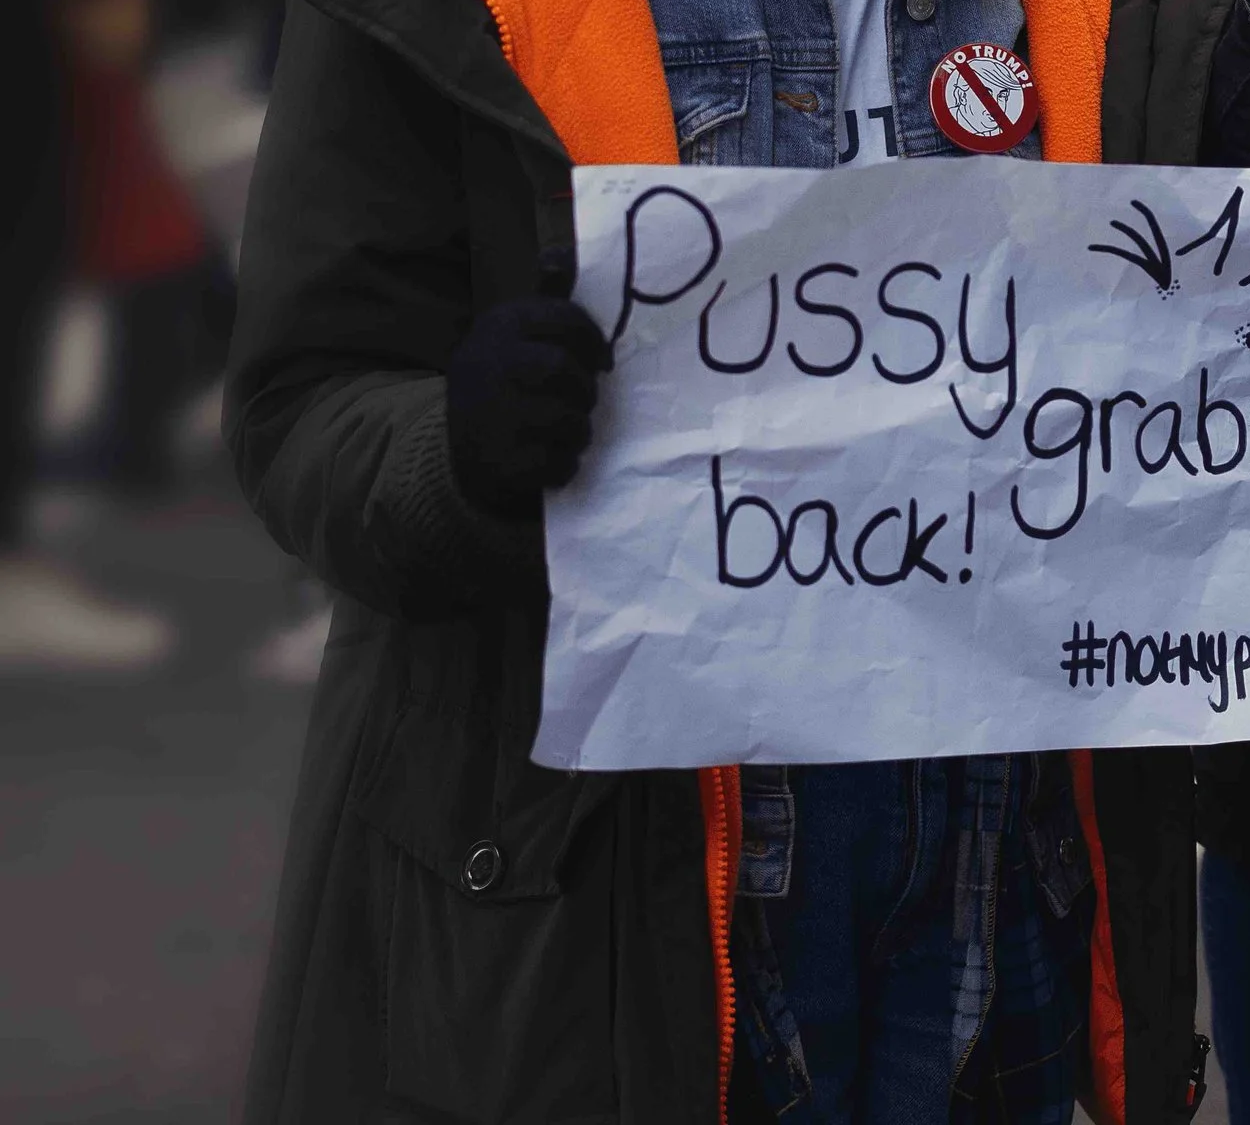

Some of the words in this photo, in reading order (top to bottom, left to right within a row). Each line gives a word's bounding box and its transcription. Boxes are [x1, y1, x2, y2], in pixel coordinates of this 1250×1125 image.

[941, 51, 967, 74] NO
[972, 46, 1033, 88] TRUMP!
[609, 186, 1017, 440] Pussy
[711, 454, 976, 588] back!
